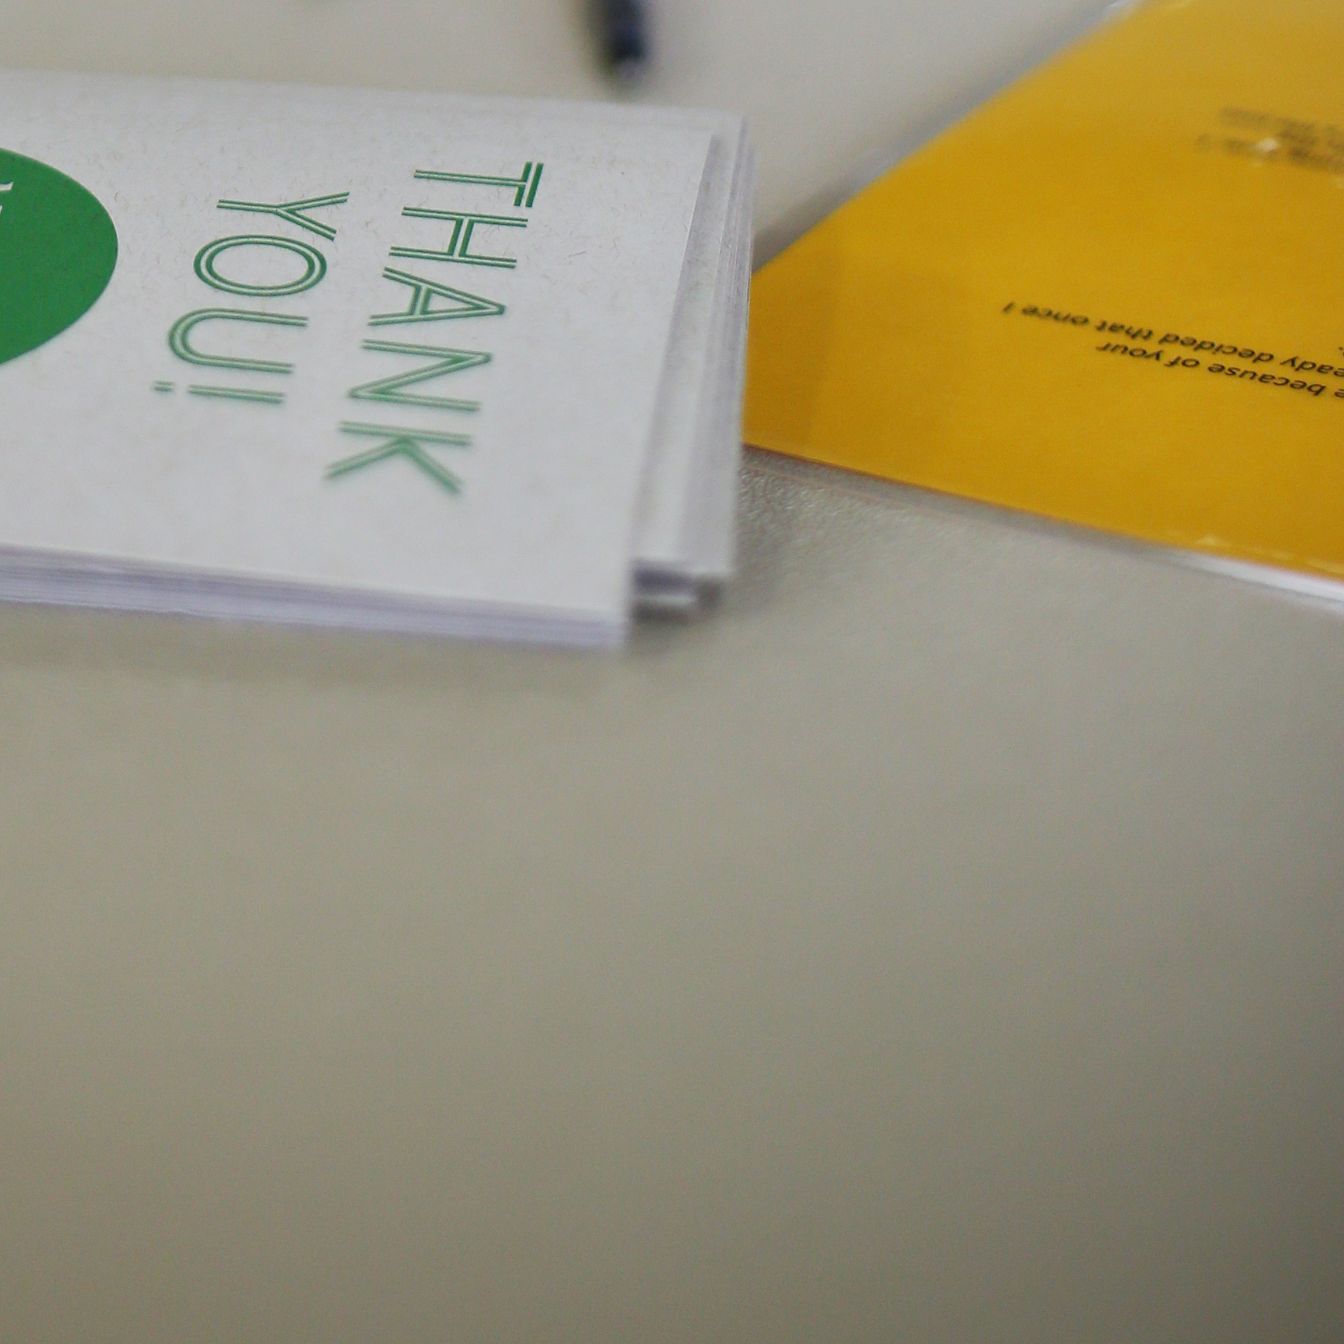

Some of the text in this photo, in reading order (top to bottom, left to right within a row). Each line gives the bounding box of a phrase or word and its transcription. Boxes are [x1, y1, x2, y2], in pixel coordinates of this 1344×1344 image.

[152, 189, 350, 404] YOU!
[1021, 303, 1090, 326] once
[323, 160, 545, 497] THANK
[1096, 319, 1154, 340] that
[1096, 341, 1164, 362] your
[1158, 332, 1274, 364] decided
[1164, 354, 1200, 368] of
[1207, 362, 1327, 397] because
